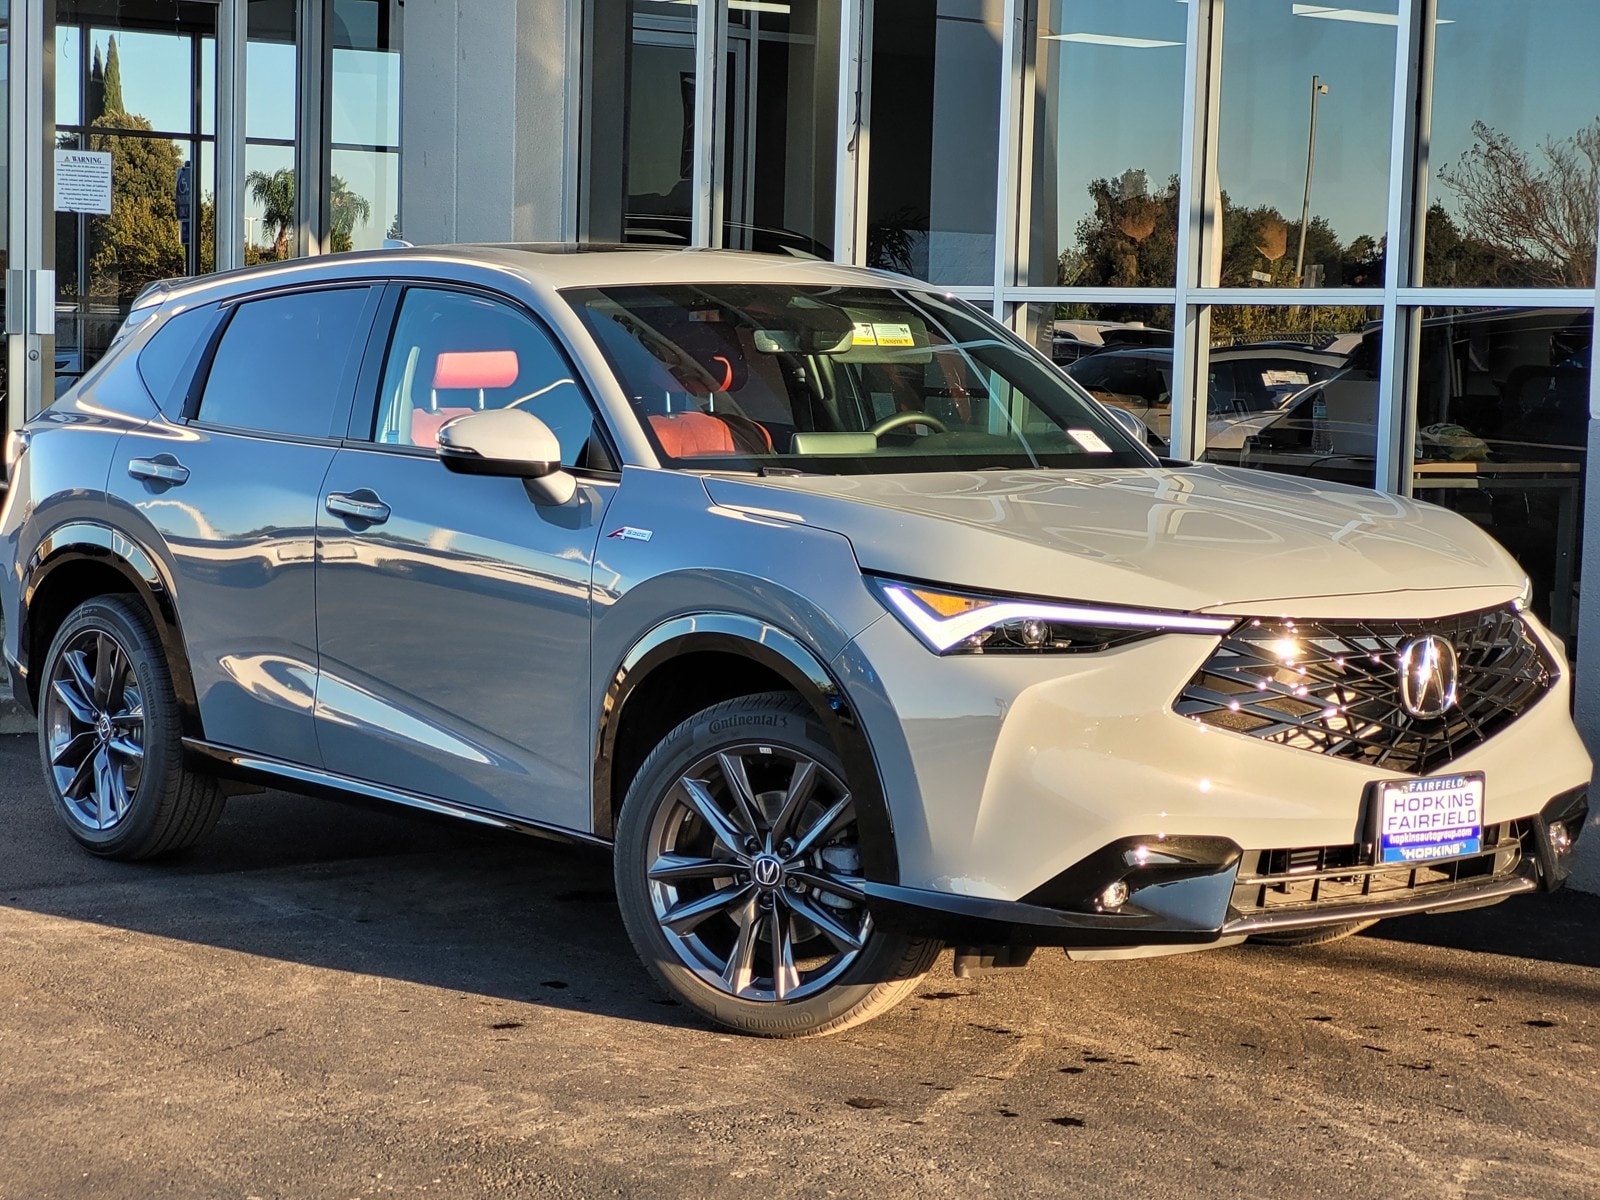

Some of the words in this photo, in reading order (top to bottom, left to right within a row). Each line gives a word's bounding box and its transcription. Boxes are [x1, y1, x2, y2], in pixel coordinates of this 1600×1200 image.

[72, 156, 102, 164] WARNING
[140, 661, 157, 720] Continental
[708, 714, 779, 734] Continental
[1408, 778, 1464, 792] FAIRFIELD
[1393, 792, 1475, 813] HOPKINS
[1388, 809, 1477, 830] FAIRFIELD
[1389, 828, 1473, 846] hopkinsautogroup.com
[1405, 843, 1461, 860] HOPKINS
[745, 1010, 816, 1029] Continental
